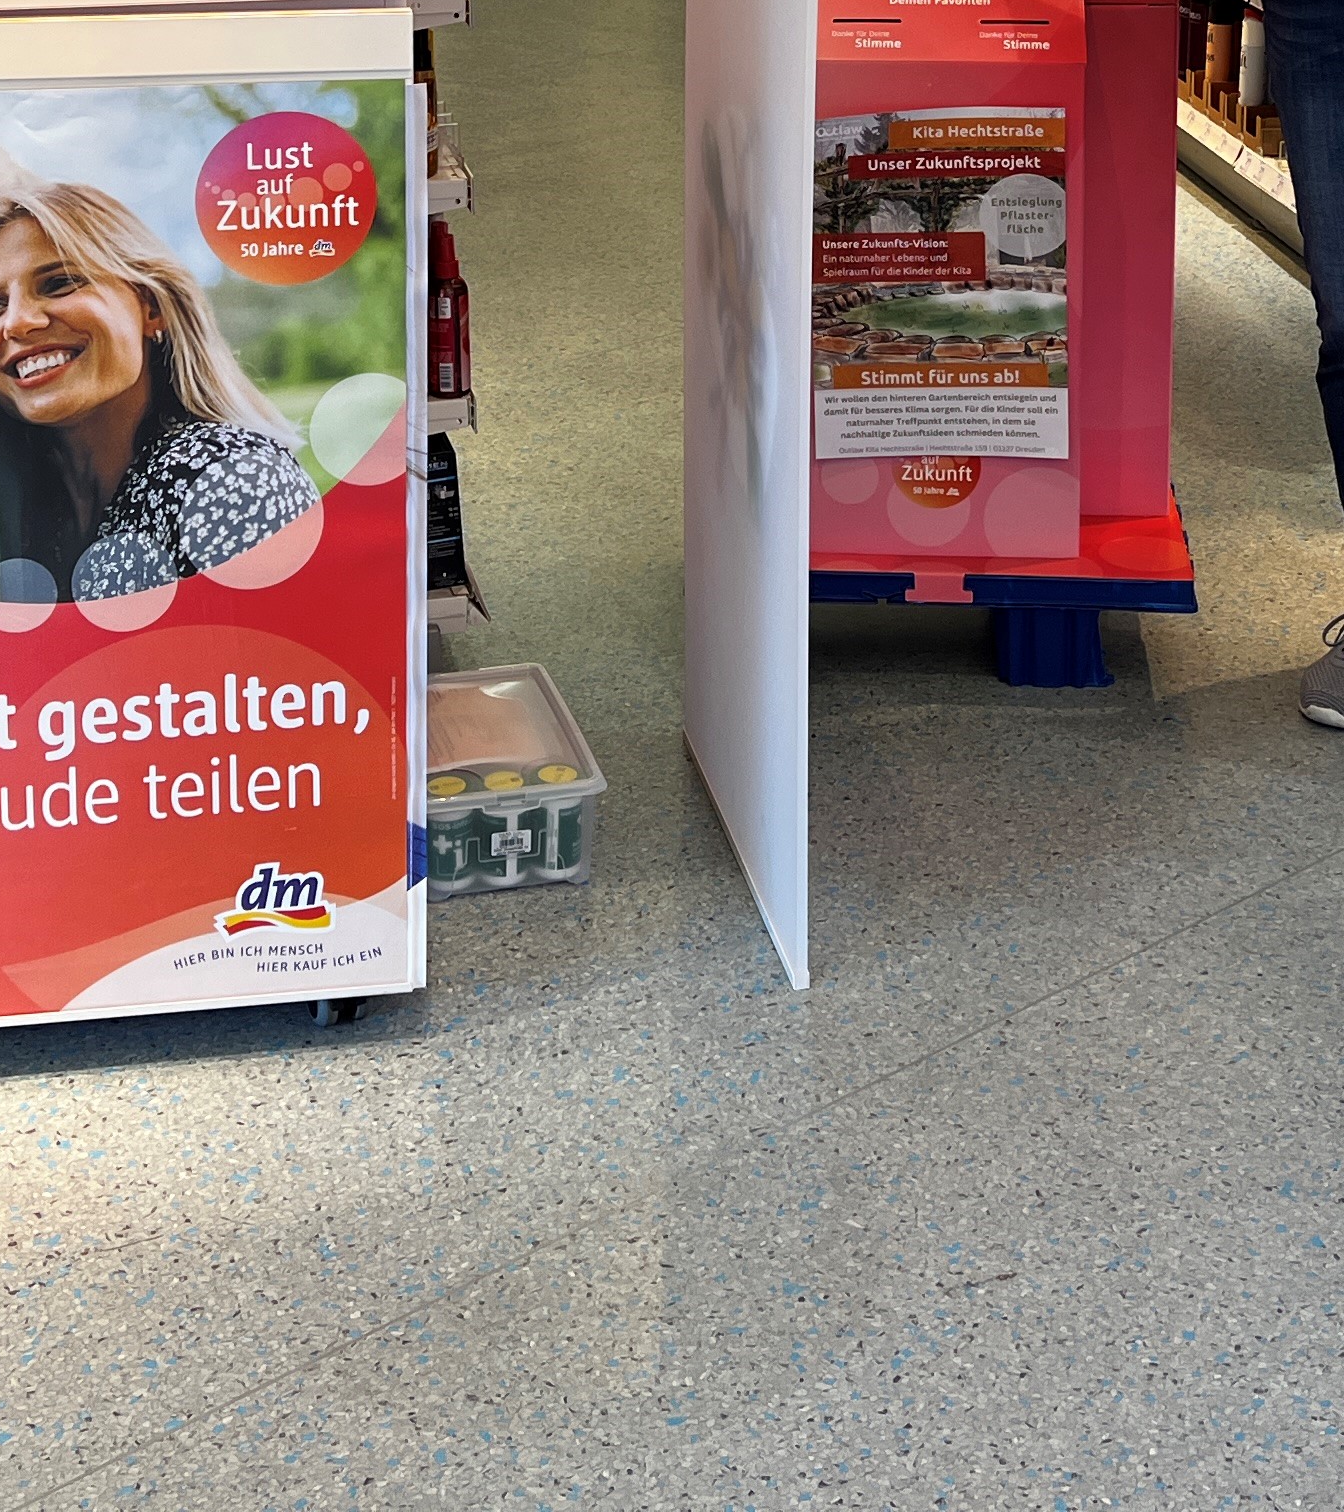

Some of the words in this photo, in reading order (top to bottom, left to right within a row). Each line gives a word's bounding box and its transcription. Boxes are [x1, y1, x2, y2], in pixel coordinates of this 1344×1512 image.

[854, 38, 902, 49] Stimme
[1003, 39, 1051, 51] Stimme
[912, 125, 944, 139] Kita
[947, 123, 1044, 139] Hechtstraße
[246, 141, 314, 171] Lust
[867, 157, 913, 171] Unser
[915, 156, 1042, 173] Zukunftsprojekt
[256, 173, 294, 196] auf
[216, 194, 360, 231] Zukunft
[240, 243, 259, 258] 50
[262, 240, 304, 258] Jahre
[822, 239, 860, 249] Unsere
[861, 371, 924, 386] Stimmt
[928, 370, 955, 385] für
[959, 372, 989, 385] uns
[993, 370, 1020, 385] ab!
[901, 464, 973, 483] Zukunft
[46, 670, 372, 763] gestalten,
[142, 755, 322, 818] teilen
[241, 867, 319, 911] dm
[173, 952, 206, 970] HIER
[211, 947, 235, 960] BIN
[240, 945, 263, 957] ICH
[268, 943, 324, 957] MENSCH
[256, 961, 288, 973] HIER
[293, 958, 328, 972] KAUF
[332, 953, 355, 968] ICH
[360, 946, 383, 962] EIN
